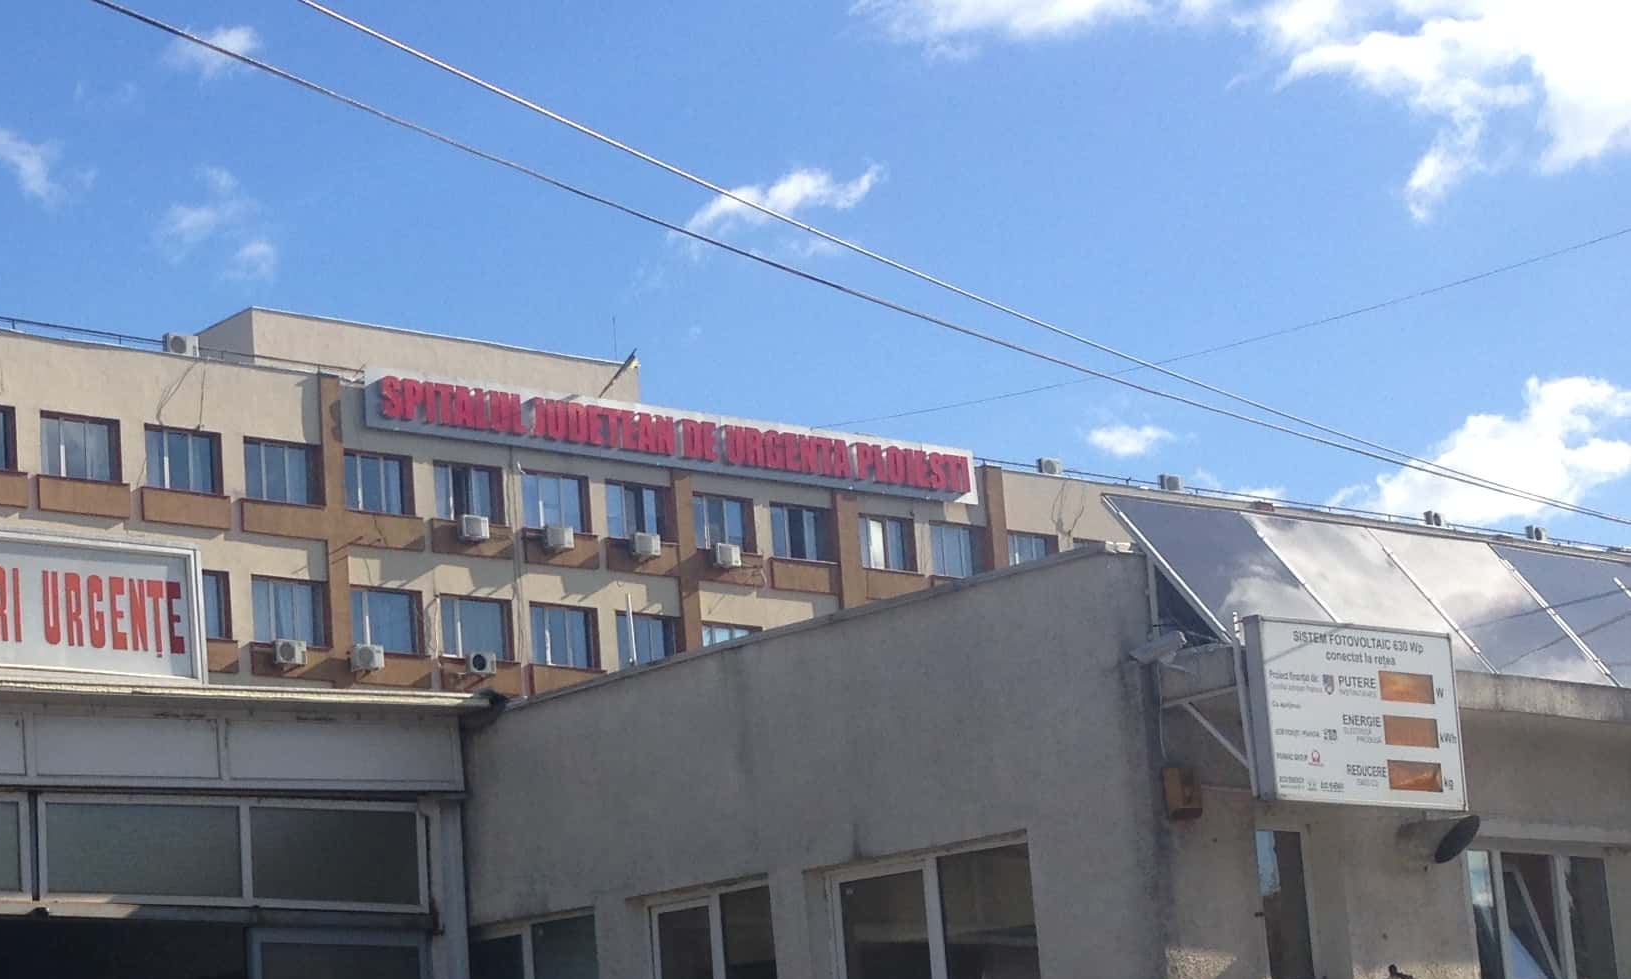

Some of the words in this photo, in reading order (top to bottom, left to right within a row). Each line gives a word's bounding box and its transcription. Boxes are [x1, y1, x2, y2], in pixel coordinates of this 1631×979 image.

[381, 376, 527, 435] SPITALUL
[681, 418, 718, 462] DE
[1293, 630, 1327, 644] SISTEM
[1329, 632, 1391, 651] FOTOVOLTAIC
[1326, 651, 1363, 664] conectat
[1364, 652, 1372, 665] la
[1338, 675, 1377, 689] PUTERE
[1436, 687, 1444, 698] W
[1342, 714, 1382, 728] ENERGIE
[1346, 764, 1387, 778] REDUCERE
